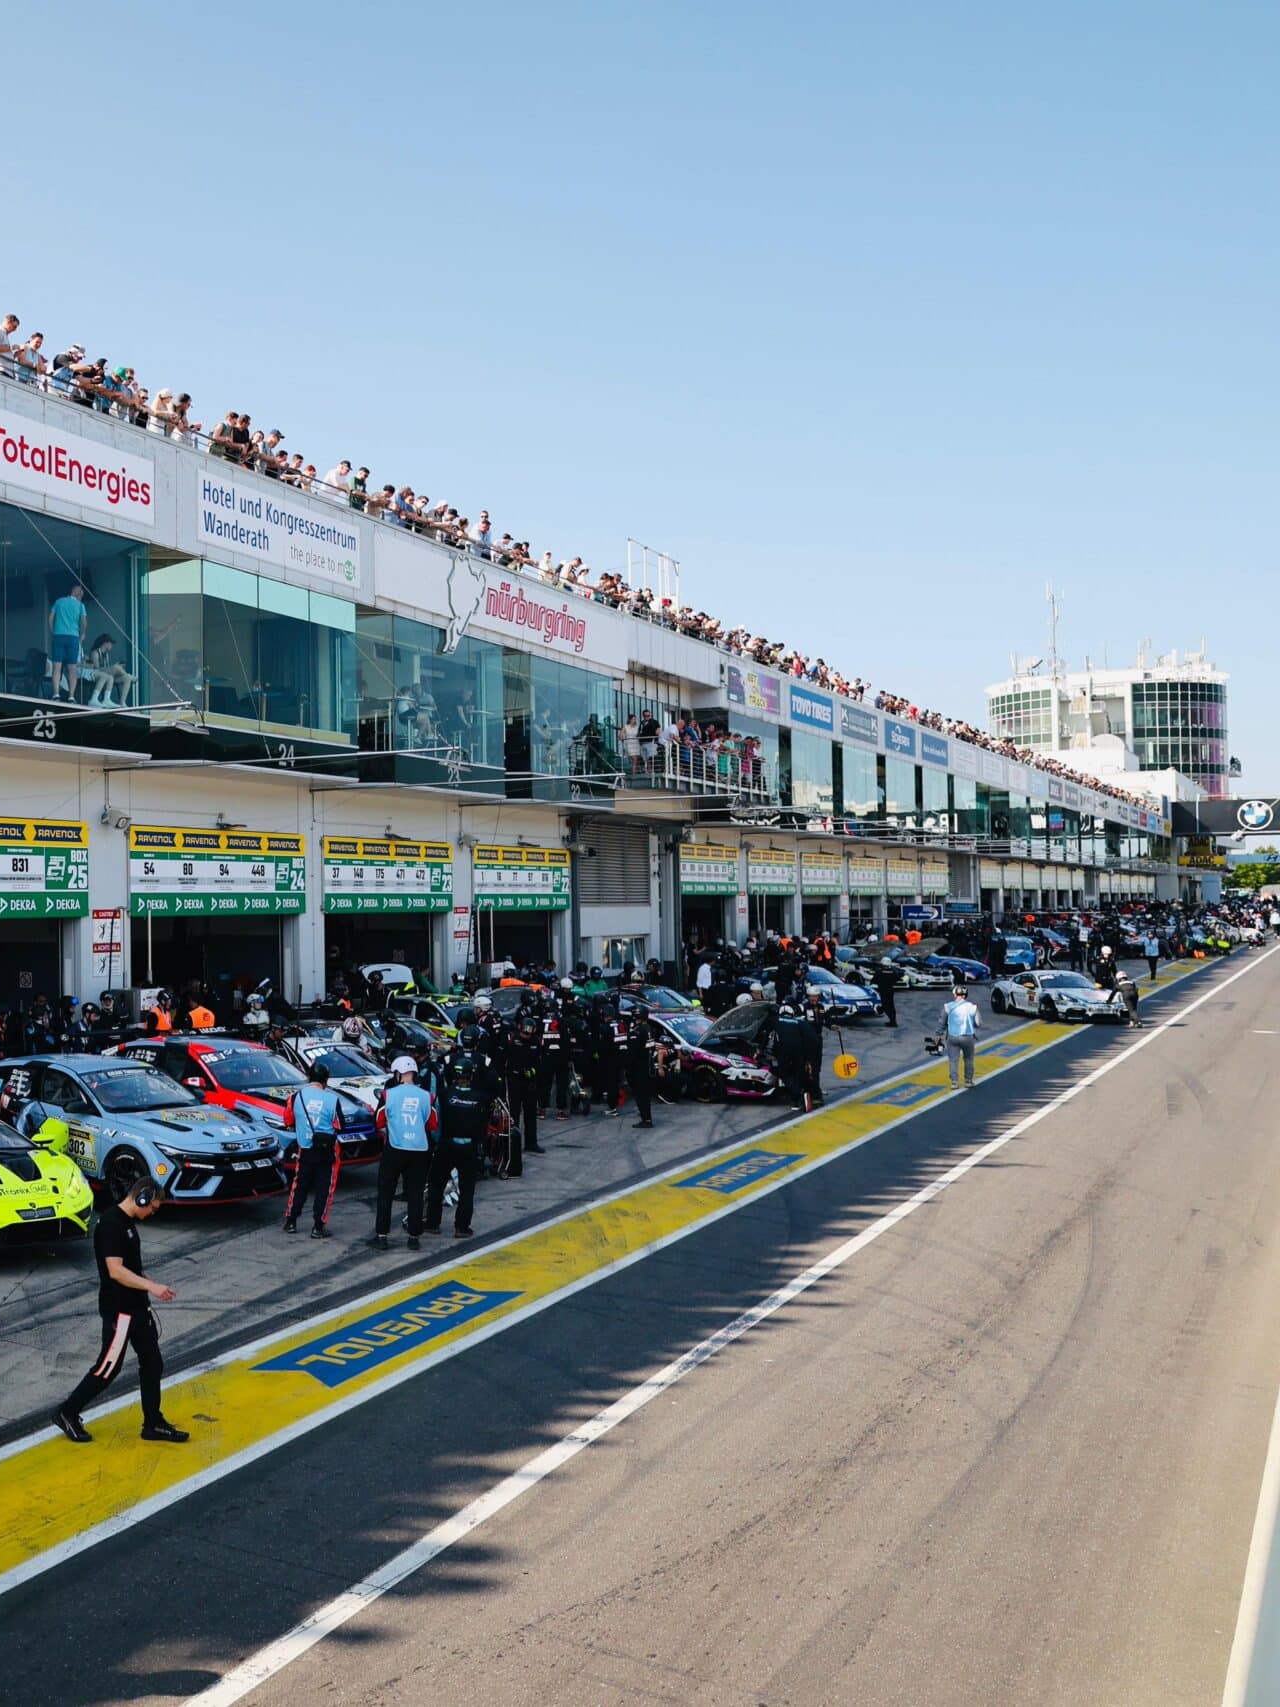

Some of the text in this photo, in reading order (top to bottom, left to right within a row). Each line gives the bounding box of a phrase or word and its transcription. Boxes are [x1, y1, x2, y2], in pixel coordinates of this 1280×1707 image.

[202, 479, 357, 552] Hotel und Kongresszentrum
[203, 510, 270, 552] Wanderath
[290, 544, 305, 560] the
[306, 550, 325, 571] place
[485, 582, 587, 653] nürburgring
[791, 695, 832, 724] TOYO TIRES
[32, 708, 57, 740] 25
[277, 743, 296, 769] 24
[38, 829, 79, 840] RAVENOL
[137, 835, 172, 844] RAVENOL
[185, 837, 218, 846] RAVENOL
[229, 839, 259, 848] RAVENOL
[269, 841, 298, 850] RAVENOL
[70, 850, 88, 863] BOX
[1189, 857, 1215, 866] ADAC
[11, 858, 29, 873] 831
[144, 862, 155, 876] 54
[67, 865, 88, 889] 25
[332, 867, 339, 878] 37
[290, 871, 305, 891] 24
[10, 898, 36, 912] DEKRA
[56, 897, 81, 910] DEKRA
[147, 899, 169, 910] DEKRA
[183, 899, 204, 910] DEKRA
[219, 898, 238, 909] DEKRA
[251, 898, 270, 908] DEKRA
[282, 898, 300, 908] DEKRA
[401, 1114, 418, 1126] TV
[296, 1288, 486, 1367] RAVENOL
